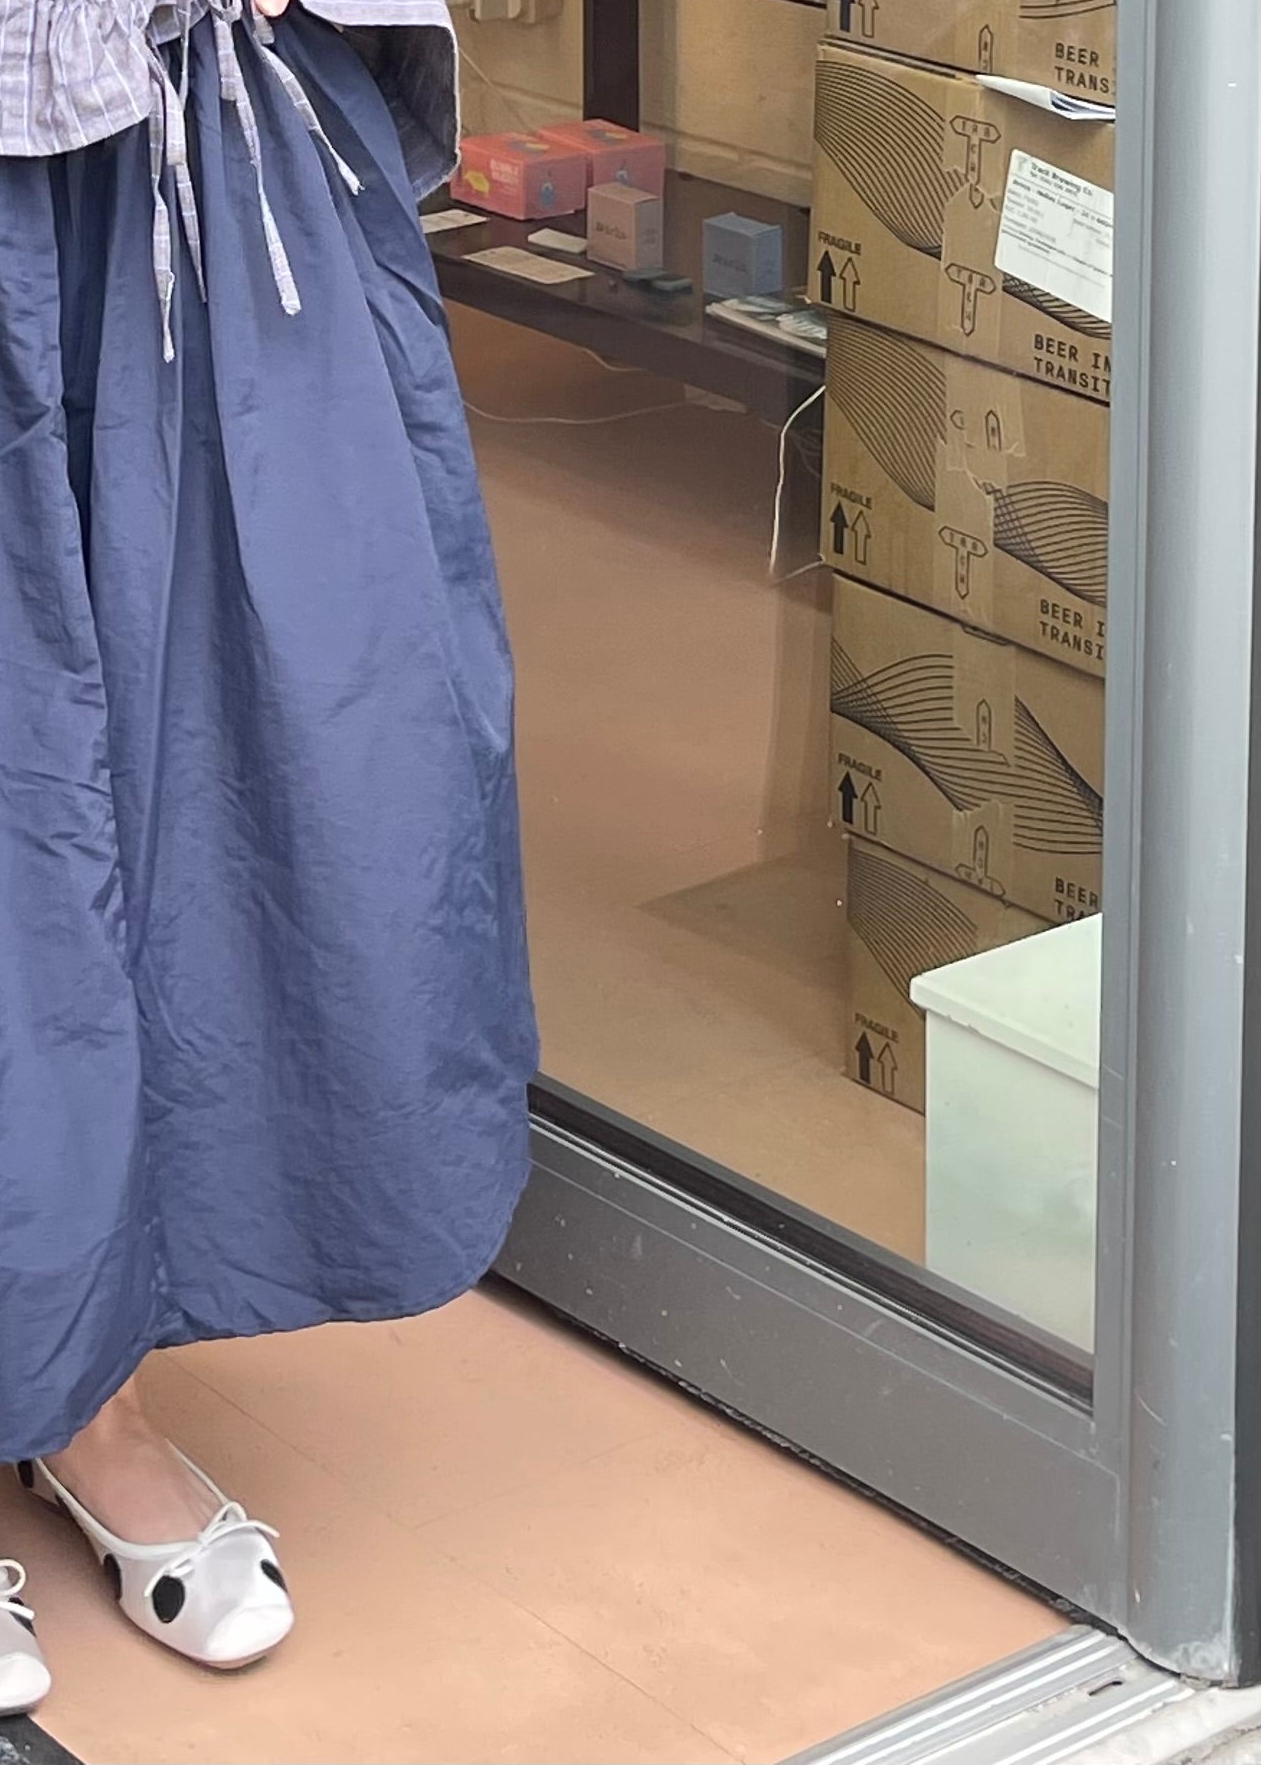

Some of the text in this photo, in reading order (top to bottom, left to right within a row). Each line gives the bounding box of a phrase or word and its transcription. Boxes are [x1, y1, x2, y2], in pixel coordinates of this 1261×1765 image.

[1055, 42, 1100, 68] BEER
[1054, 65, 1115, 95] TRANS
[818, 231, 861, 256] FRAGILE
[1034, 333, 1078, 363] BEER
[1033, 356, 1111, 396] TRANSIT
[830, 482, 873, 510] FRAGILE
[1040, 598, 1106, 638] BEER I
[1038, 620, 1105, 661] TRANSI
[838, 752, 882, 782] FRAGILE
[1055, 876, 1099, 911] BEER
[854, 1012, 900, 1044] FRAGILE
